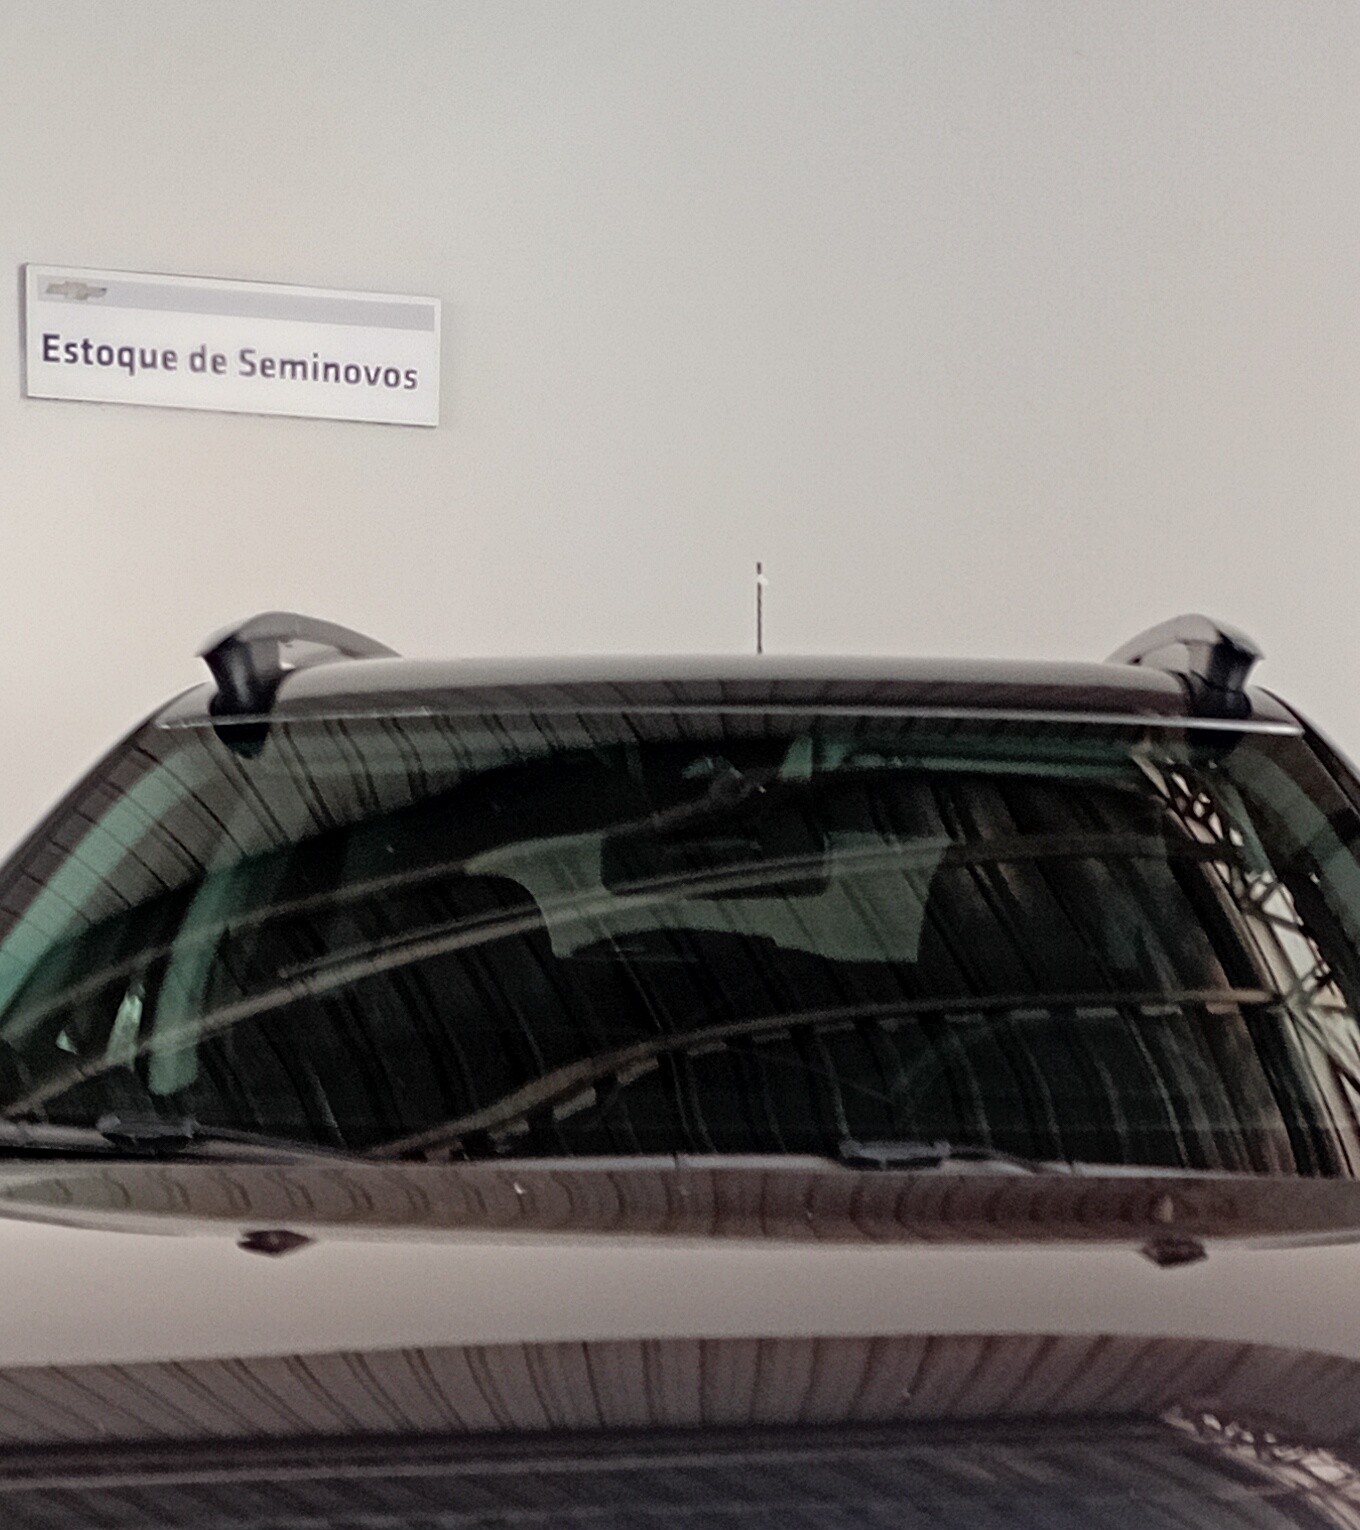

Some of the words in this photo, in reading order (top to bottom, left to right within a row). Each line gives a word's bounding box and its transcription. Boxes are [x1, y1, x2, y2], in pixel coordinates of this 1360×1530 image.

[41, 332, 178, 377] Estoque
[189, 344, 228, 376] de
[238, 348, 419, 391] Seminovos
